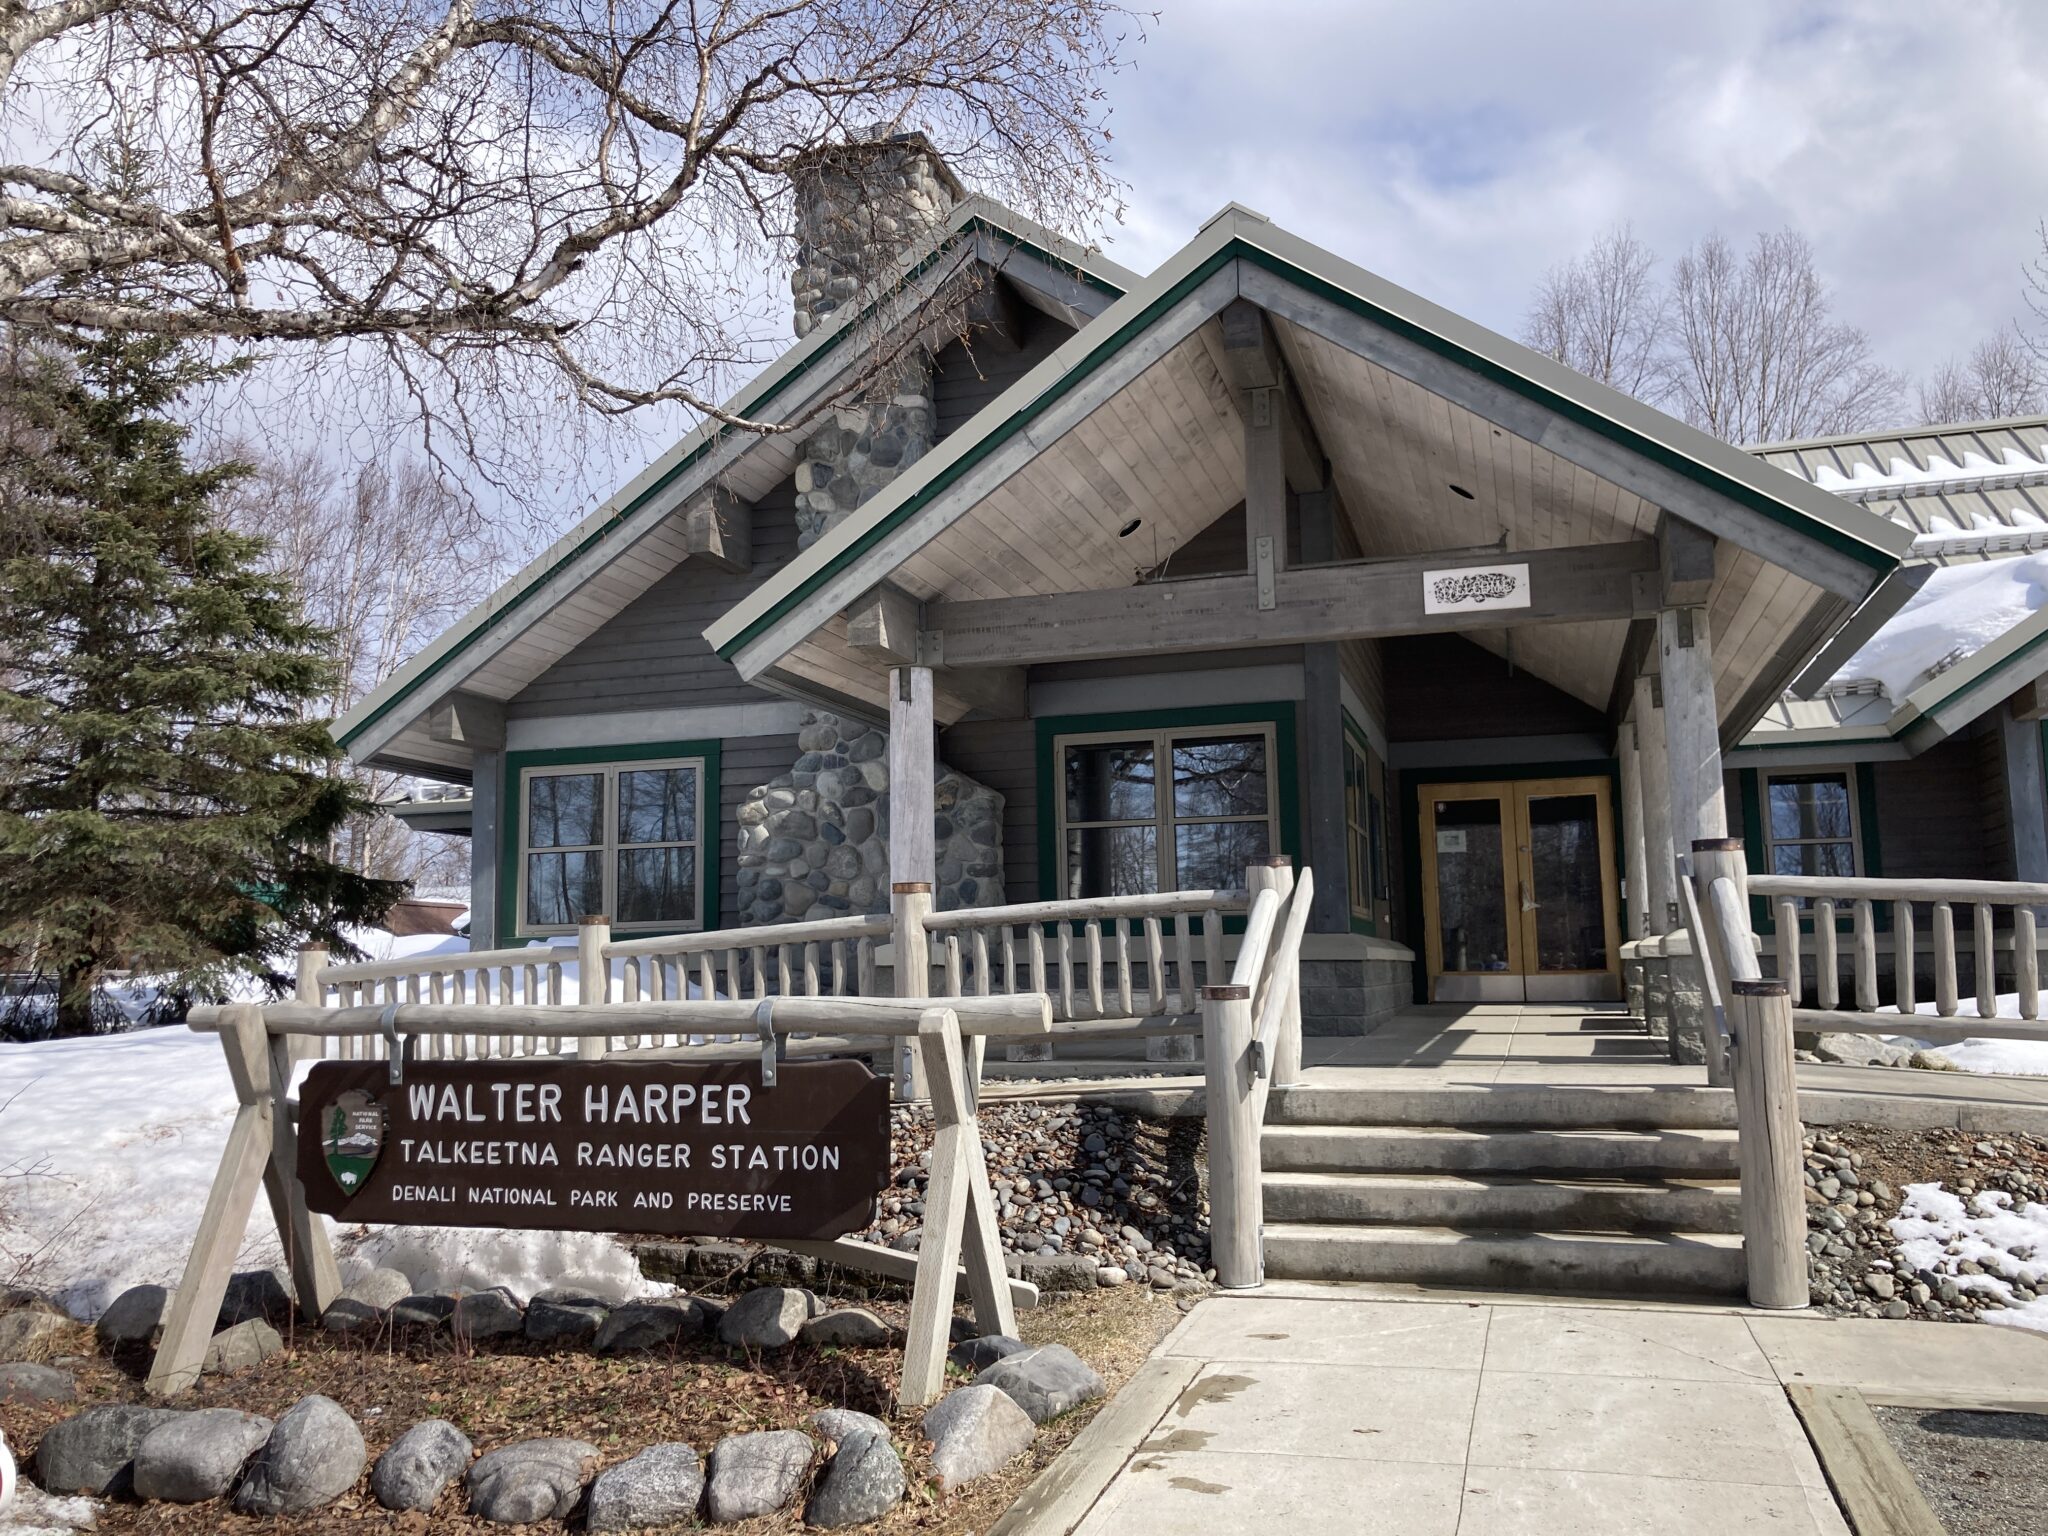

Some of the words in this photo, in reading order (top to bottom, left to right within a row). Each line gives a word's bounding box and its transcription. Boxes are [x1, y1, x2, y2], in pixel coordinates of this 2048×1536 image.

[409, 1083, 562, 1122] WALTER
[584, 1083, 751, 1125] HARPER
[400, 1139, 559, 1166] TALKEETNA
[577, 1142, 691, 1169] RANGER
[711, 1144, 839, 1171] STATION
[392, 1184, 456, 1202] DENALI
[468, 1187, 557, 1206] NATIONAL
[570, 1189, 618, 1207] PARK
[633, 1191, 674, 1209] AND
[687, 1192, 792, 1212] PRESERVE
